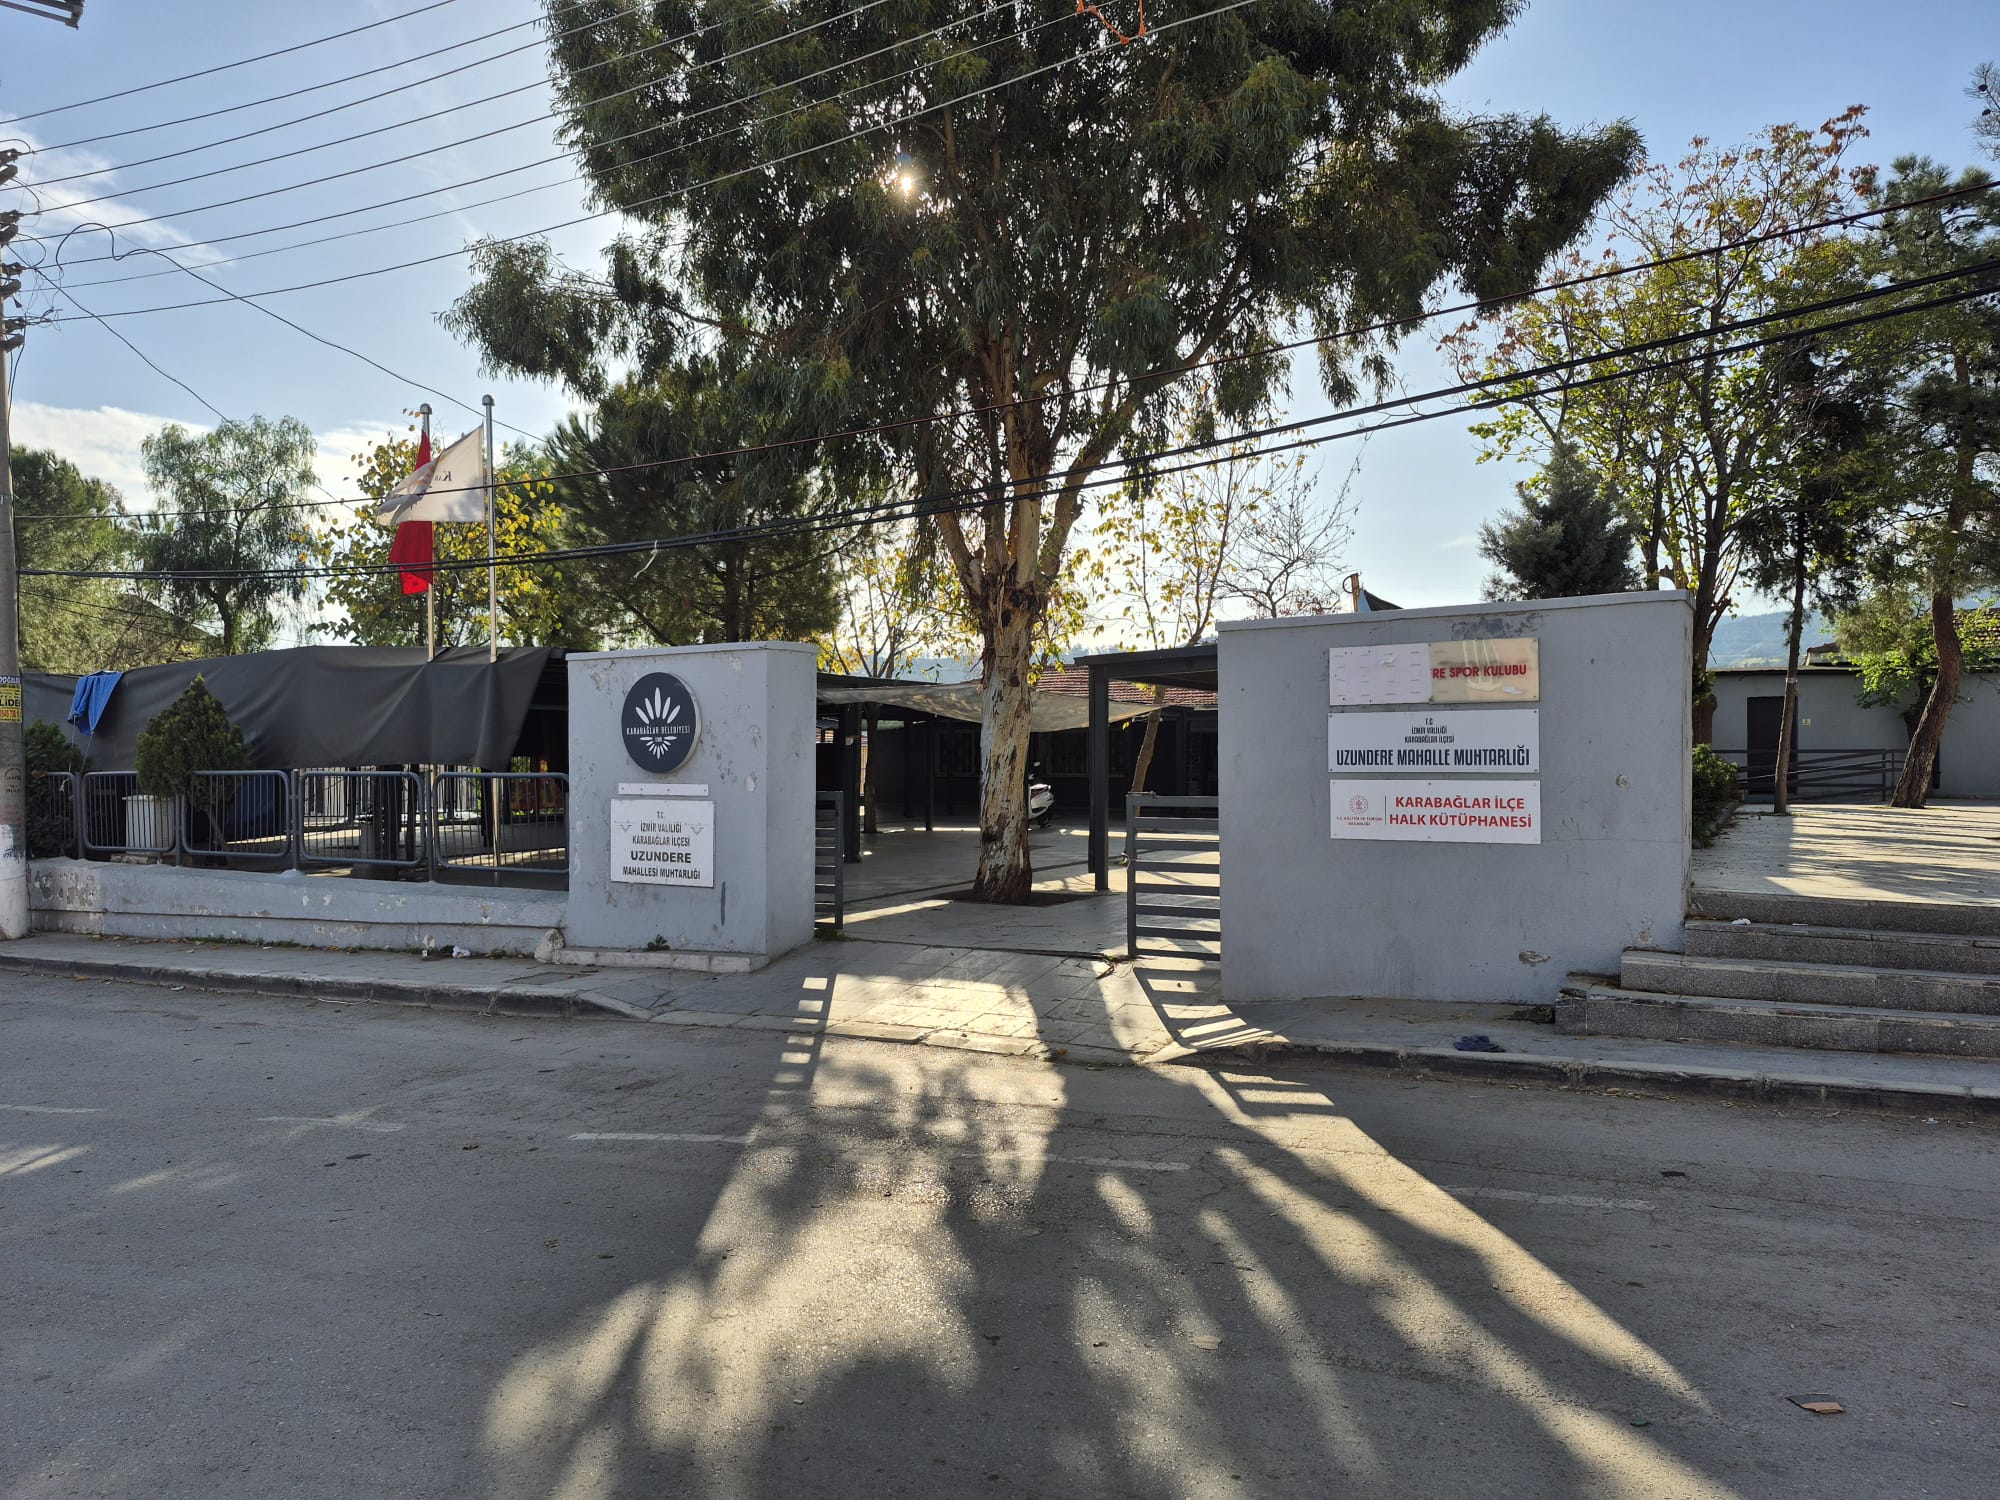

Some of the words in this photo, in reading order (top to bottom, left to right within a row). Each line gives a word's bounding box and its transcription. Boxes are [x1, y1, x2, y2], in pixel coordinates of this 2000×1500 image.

[1449, 666, 1480, 678] SPOR
[1483, 664, 1527, 677] KULUBU
[627, 726, 659, 735] KARABAĞLAR
[1336, 749, 1394, 766] UZUNDERE
[1397, 749, 1450, 766] MAHALLE
[1454, 745, 1530, 766] MUHTARLIĞI
[1395, 795, 1491, 809] KARABAĞLAR
[1494, 795, 1525, 812] İLÇE
[640, 820, 657, 833] İZMİR
[1389, 814, 1427, 826] HALK
[1429, 812, 1532, 828] KÜTÜPHANESİ
[632, 834, 670, 846] KARABAĞLAR
[630, 850, 692, 864] UZUNDERE
[660, 867, 700, 880] MUHTARLIĞI
